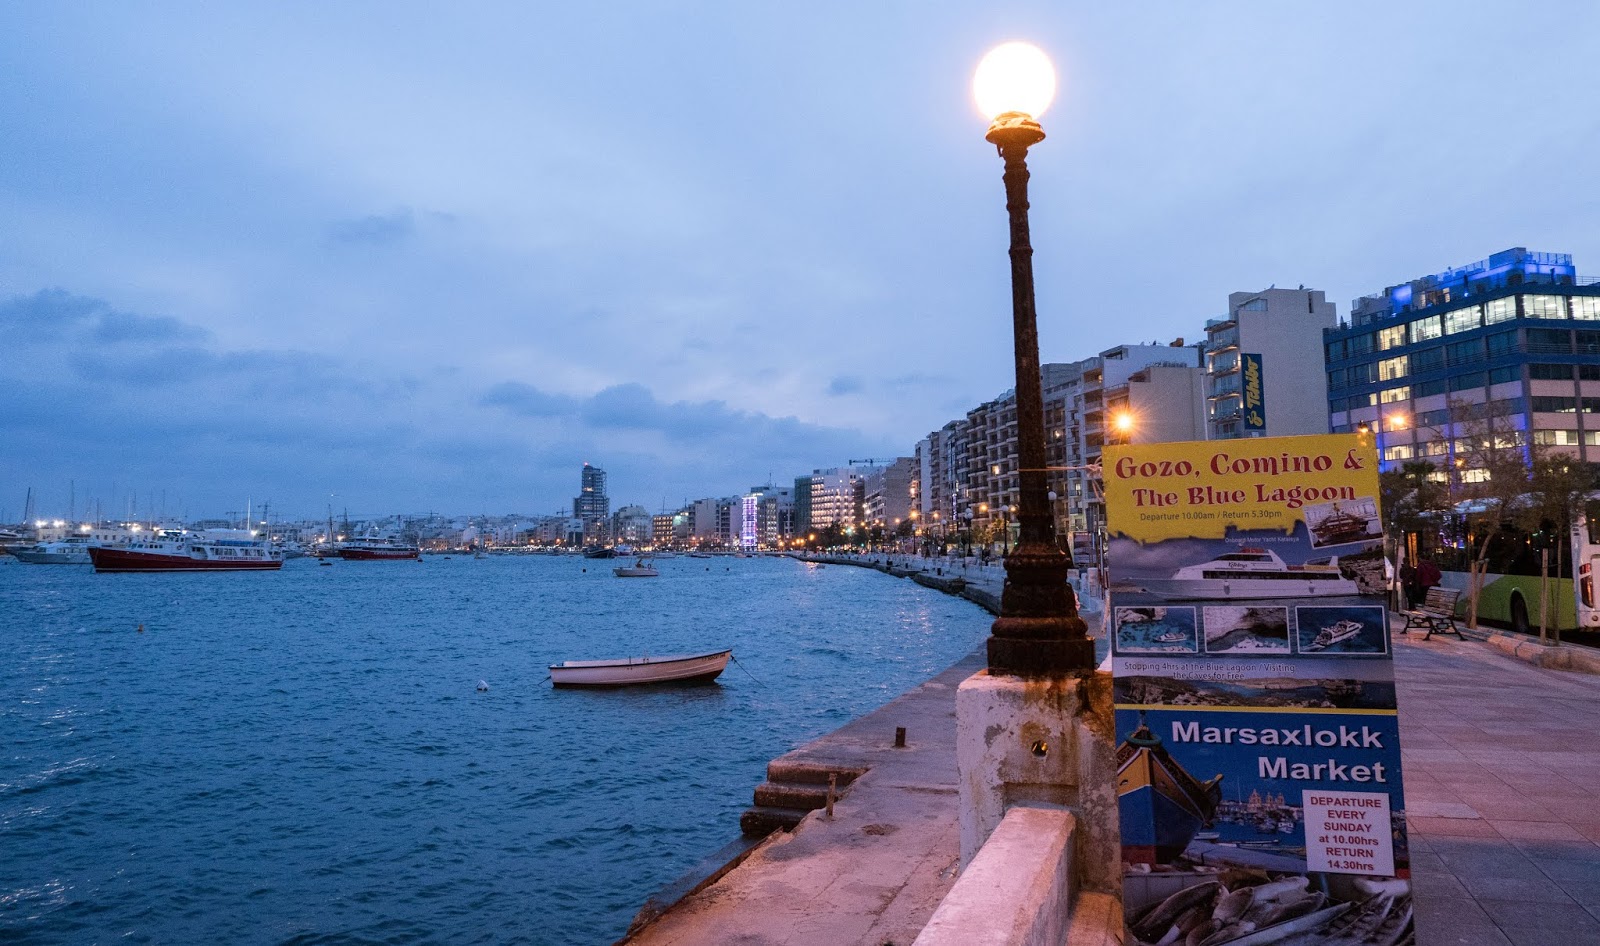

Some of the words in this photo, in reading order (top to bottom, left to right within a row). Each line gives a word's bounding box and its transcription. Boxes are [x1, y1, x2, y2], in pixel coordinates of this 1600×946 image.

[1245, 355, 1260, 409] Tchibo
[1115, 456, 1200, 480] Gozo,
[1210, 452, 1332, 476] Comino
[1343, 449, 1364, 470] &
[1132, 488, 1178, 507] The
[1186, 486, 1246, 506] Blue
[1254, 484, 1356, 508] Lagoon
[1140, 513, 1180, 522] Departure
[1252, 510, 1282, 520] 5.30pm
[1124, 662, 1160, 671] Stopping
[1206, 663, 1224, 671] Blue
[1226, 663, 1256, 672] Lagoon
[1264, 663, 1295, 673] Visiting
[1172, 721, 1384, 748] Marsaxlokk
[1258, 756, 1386, 782] Market
[1310, 797, 1382, 808] DEPARTURE
[1328, 810, 1366, 820] EVERY
[1324, 822, 1372, 832] SUNDAY
[1319, 834, 1329, 843] at
[1333, 834, 1379, 846] 10.00hrs
[1326, 847, 1374, 858] RETURN
[1327, 860, 1374, 871] 14.30hrs
